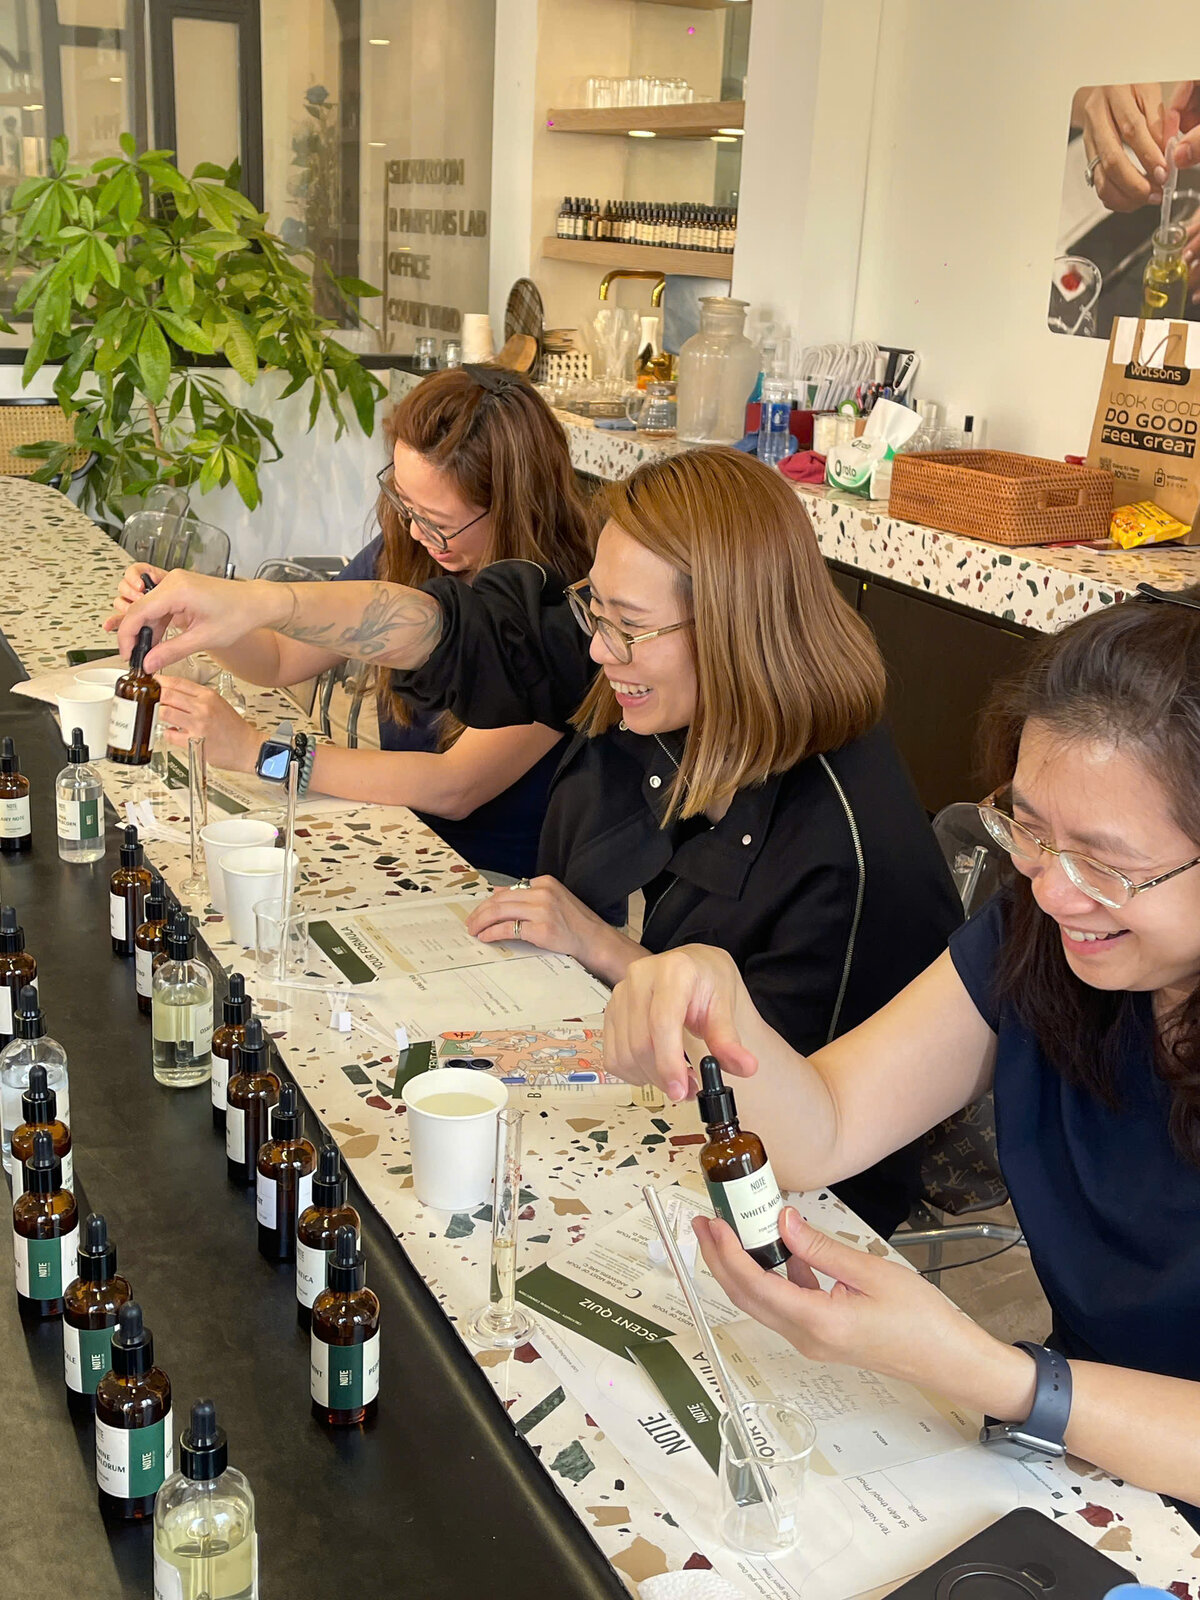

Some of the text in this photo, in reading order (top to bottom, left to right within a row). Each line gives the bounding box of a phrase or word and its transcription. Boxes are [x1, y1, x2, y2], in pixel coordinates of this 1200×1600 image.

[388, 158, 464, 185] SHOWROOM
[459, 210, 487, 237] LAB
[388, 252, 431, 280] OFFICE
[1110, 392, 1200, 416] LOOK GOOD
[1104, 408, 1198, 434] DO GOOD
[750, 1176, 766, 1190] NOTE
[740, 1204, 766, 1220] WHITE
[38, 1262, 48, 1278] NOTE
[624, 1288, 642, 1298] C
[579, 1298, 658, 1342] SCENT QUIZ
[92, 1354, 102, 1370] NOTE
[340, 1370, 349, 1386] NOTE
[686, 1403, 708, 1424] NOTE
[638, 1412, 691, 1456] NOTE
[142, 1452, 152, 1470] NOTE
